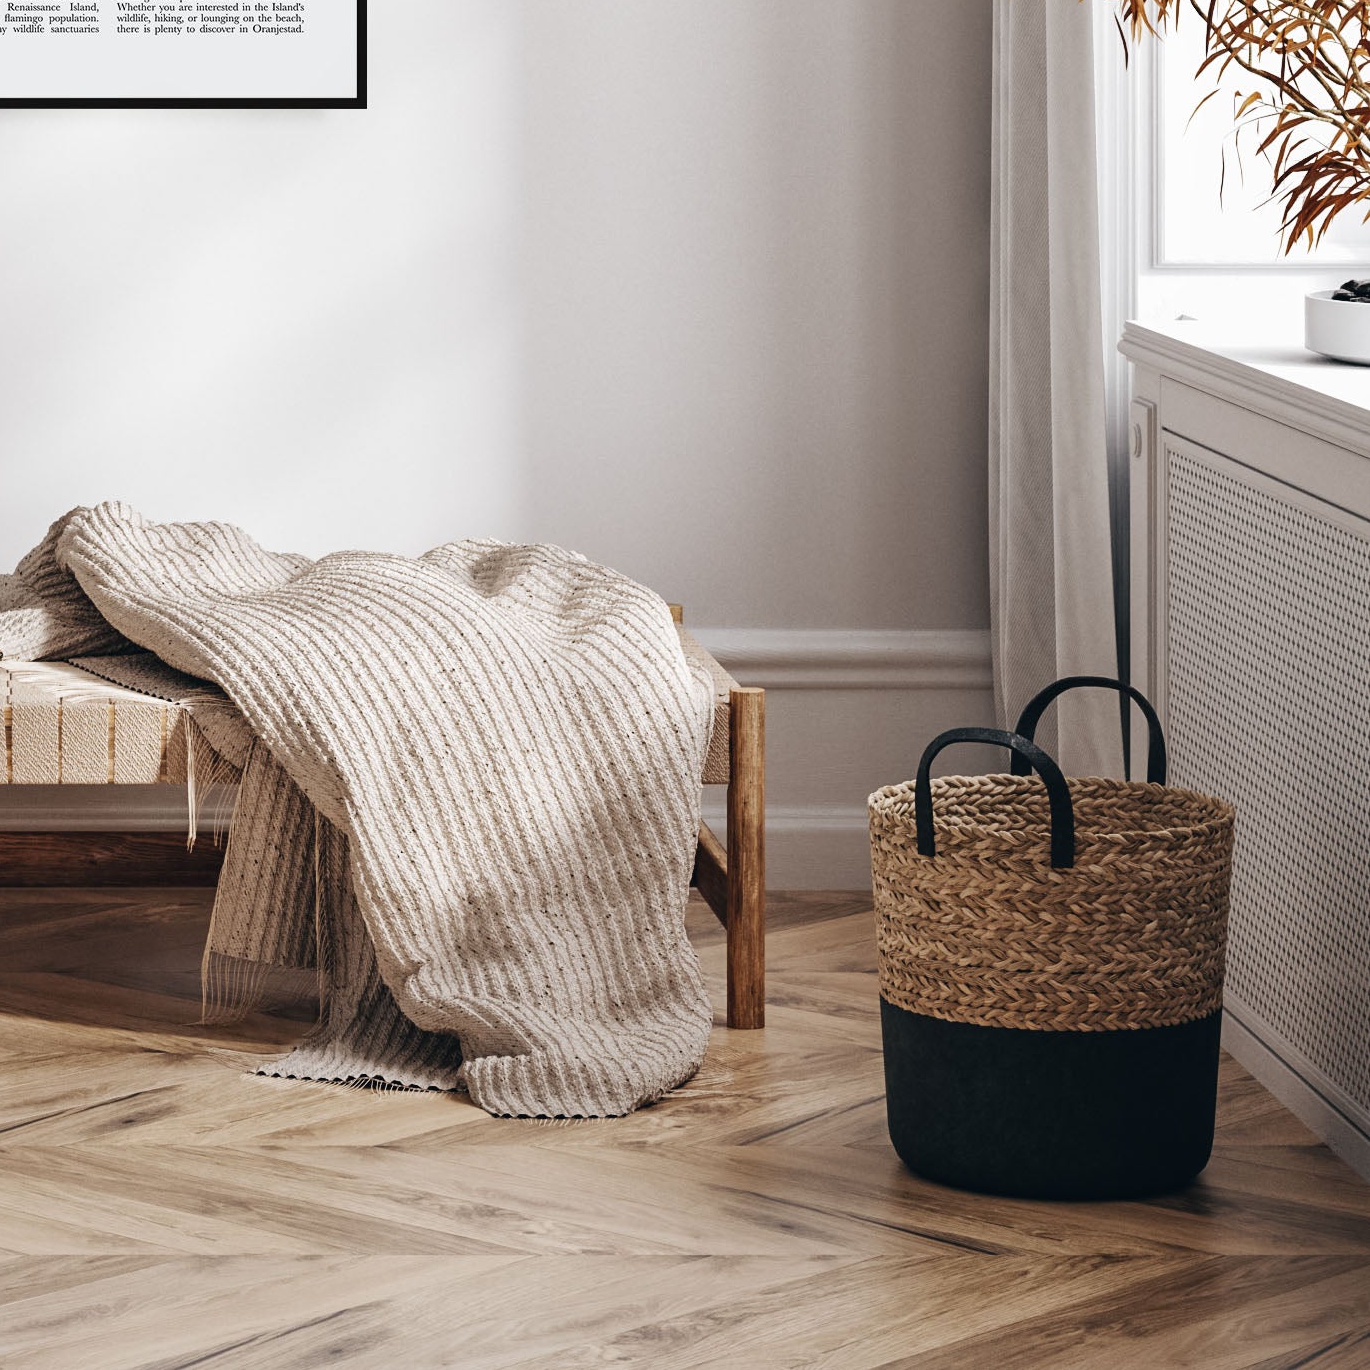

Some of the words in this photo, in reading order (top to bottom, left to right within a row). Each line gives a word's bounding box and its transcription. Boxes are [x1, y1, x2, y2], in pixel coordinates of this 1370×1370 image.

[7, 3, 61, 11] Renaissance
[70, 3, 99, 13] Island,
[117, 3, 156, 11] Whether
[159, 5, 175, 13] you
[196, 3, 239, 11] interested
[242, 3, 251, 11] in
[254, 3, 269, 11] the
[272, 3, 305, 11] Island's
[116, 14, 151, 24] wildlife,
[154, 14, 184, 24] hiking,
[201, 14, 240, 24] lounging
[258, 14, 272, 22] the
[275, 14, 305, 24] beach,
[13, 24, 45, 33] wildlife
[50, 24, 100, 33] sanctuaries
[117, 24, 140, 33] there
[144, 24, 151, 33] is
[154, 24, 183, 35] plenty
[186, 24, 196, 33] to
[199, 24, 236, 33] discover
[239, 24, 248, 33] in
[252, 24, 305, 35] Oranjestad.
